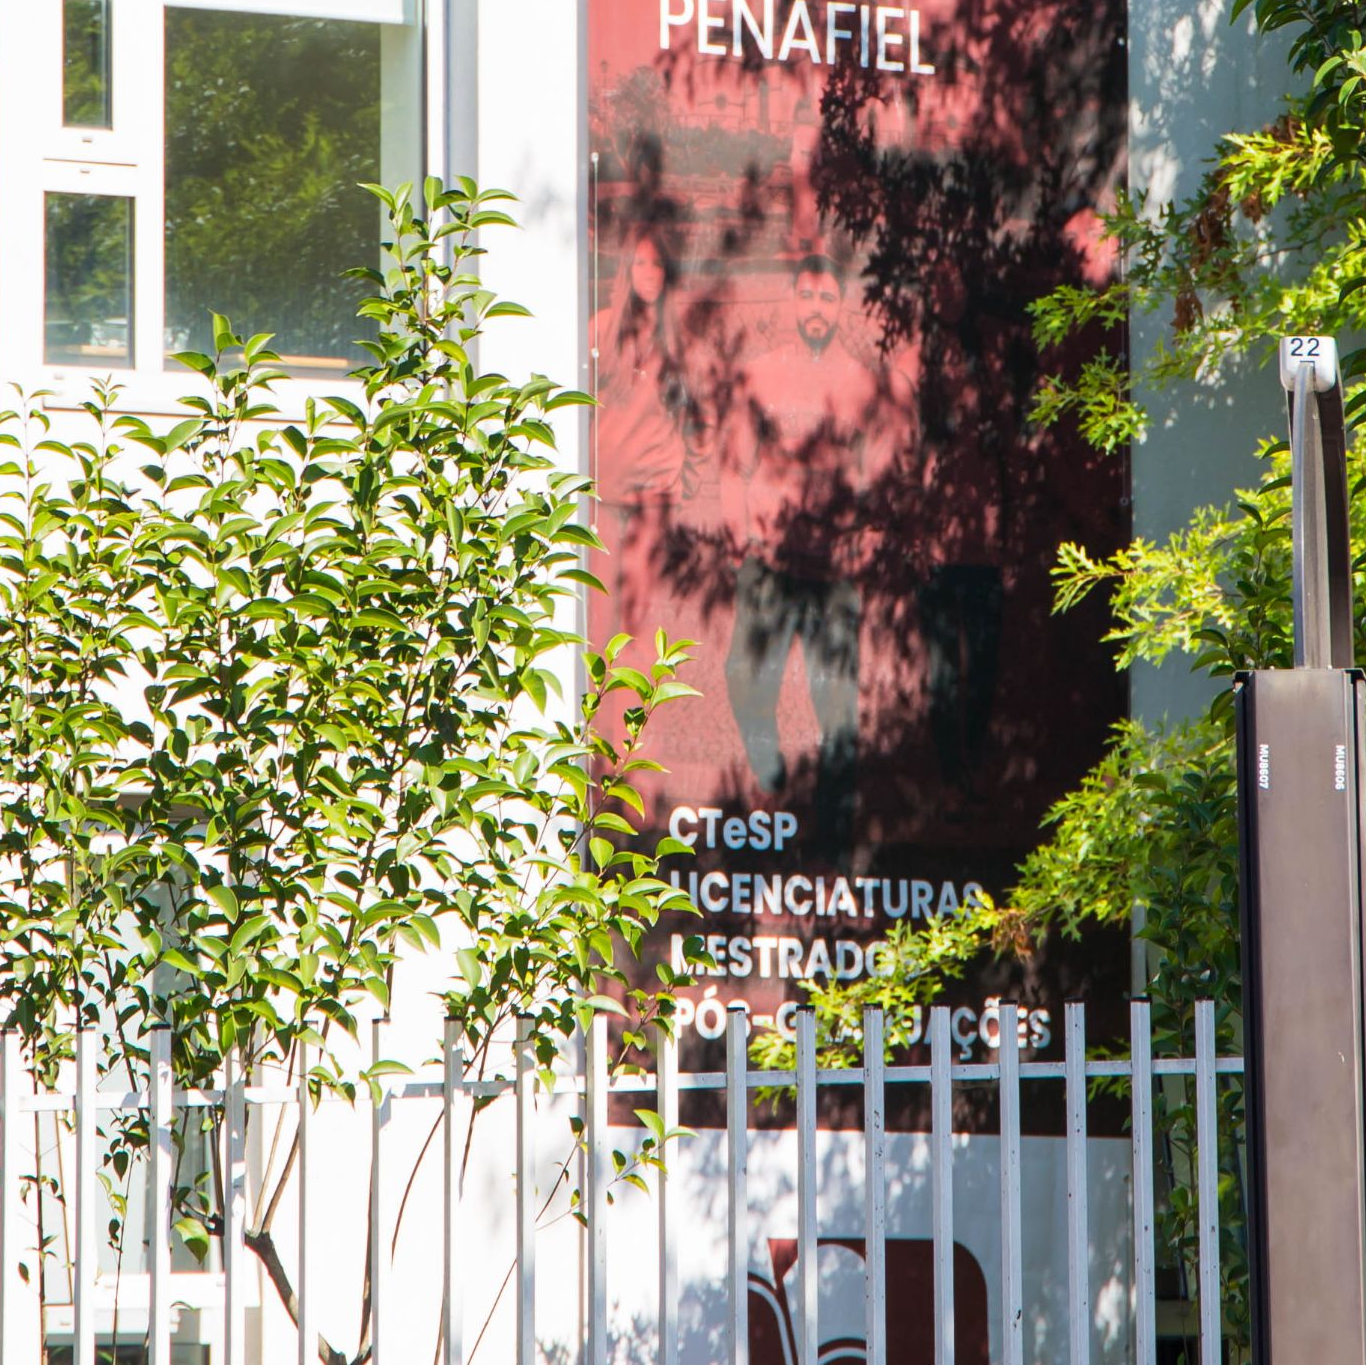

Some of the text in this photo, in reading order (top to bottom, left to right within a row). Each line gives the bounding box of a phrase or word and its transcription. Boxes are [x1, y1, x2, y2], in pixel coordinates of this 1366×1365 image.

[1290, 337, 1320, 356] 22
[1259, 744, 1269, 789] MU8607
[1335, 745, 1346, 790] MU8606
[668, 806, 798, 851] CTeSP
[671, 933, 921, 982] MESTRADO
